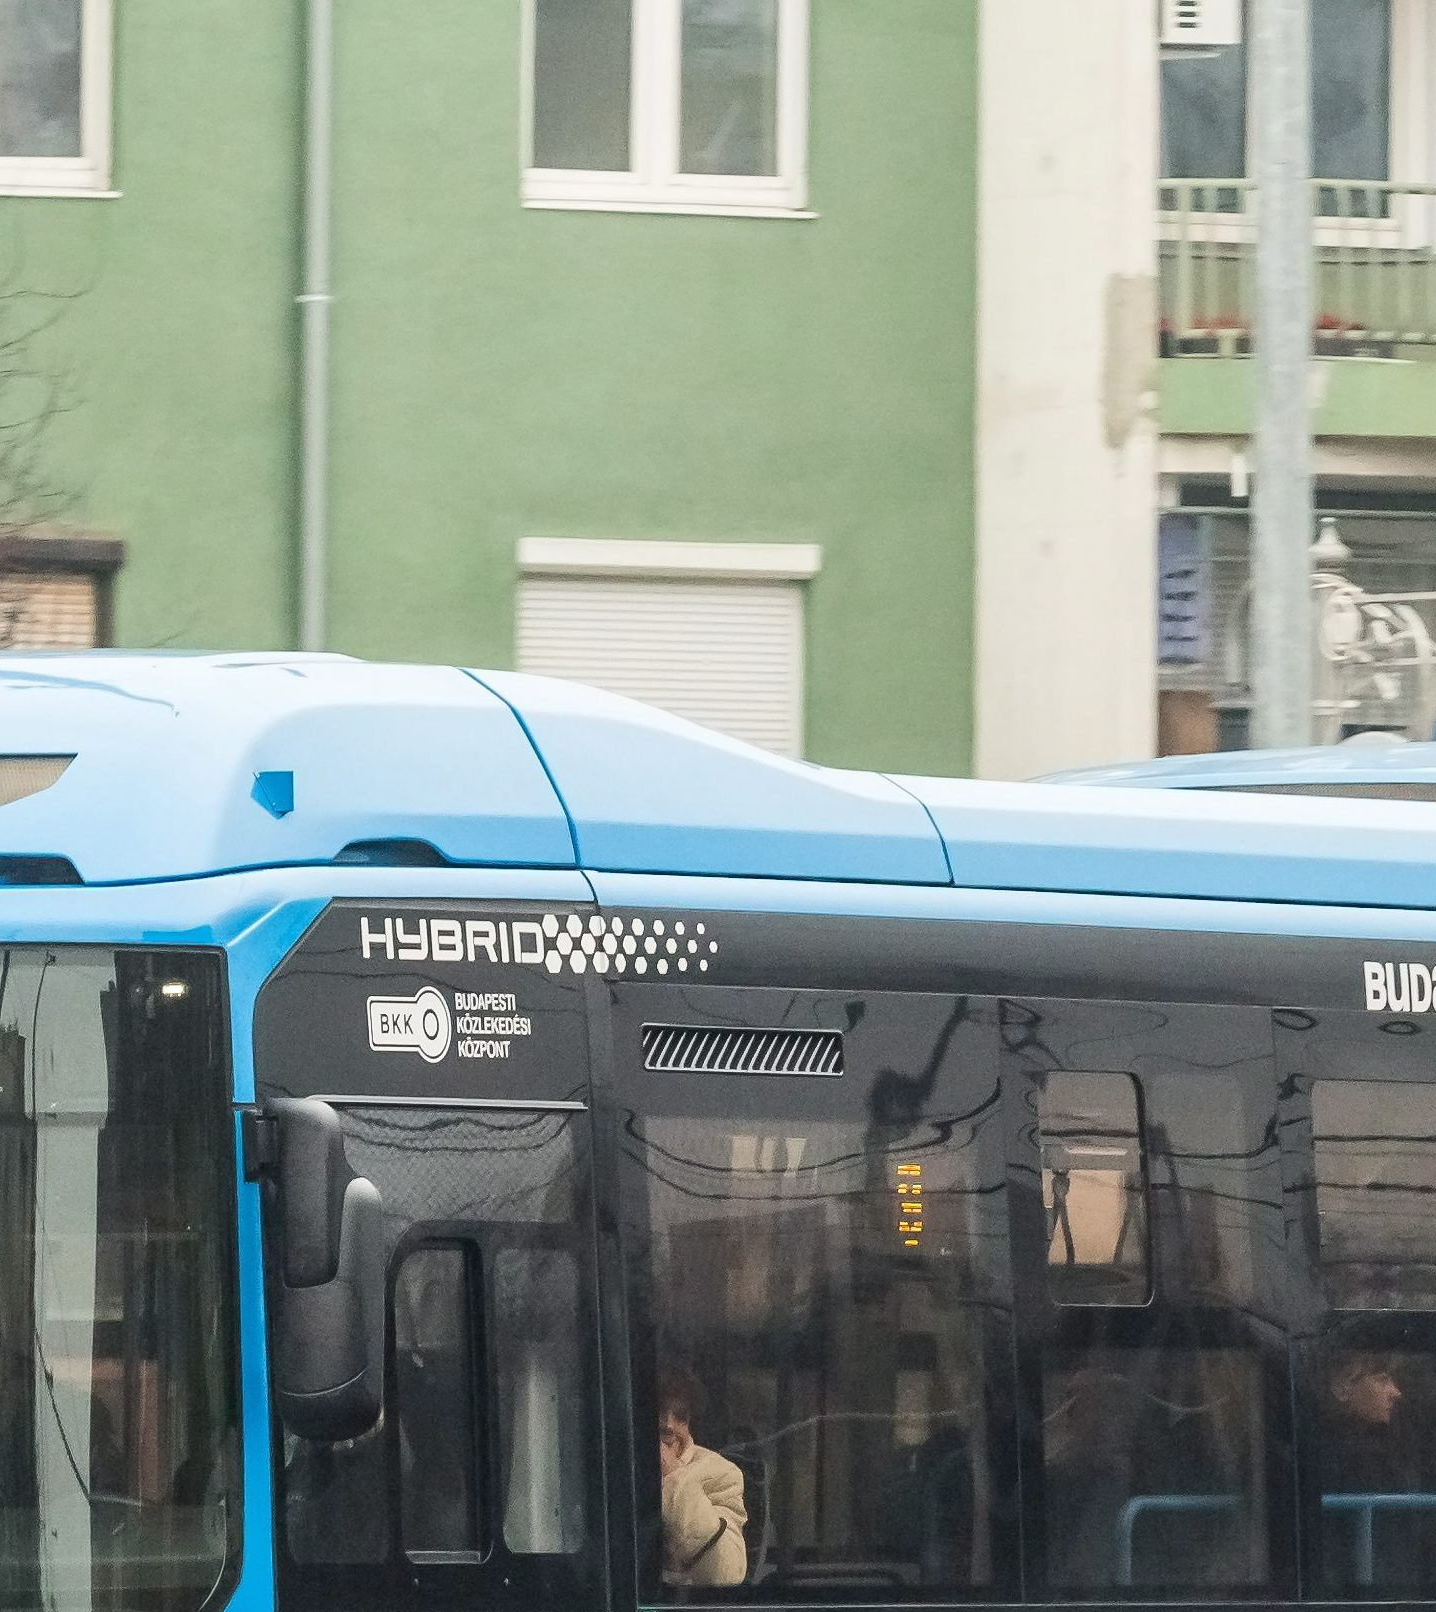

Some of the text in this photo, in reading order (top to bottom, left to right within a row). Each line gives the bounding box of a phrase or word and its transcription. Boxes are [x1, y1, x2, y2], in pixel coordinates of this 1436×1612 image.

[360, 917, 545, 963] HYBRID
[454, 992, 516, 1012] BUDAPESTI
[380, 1012, 414, 1035] BKK
[455, 1013, 532, 1036] KÖZLEKEDÉSI
[457, 1037, 511, 1059] KÖZPONT
